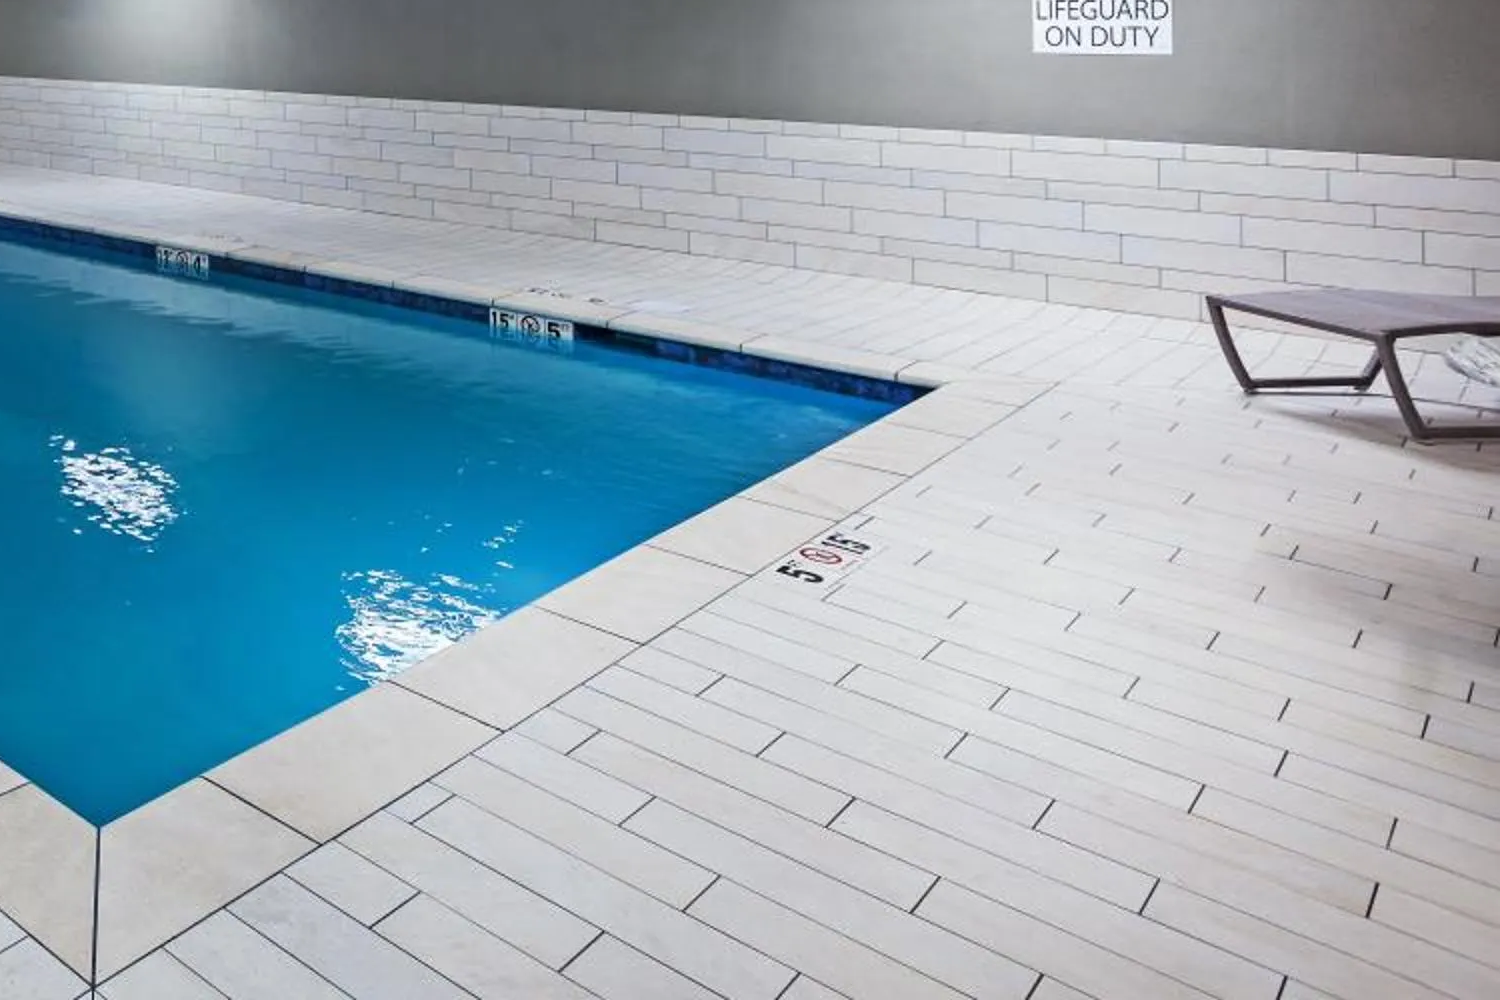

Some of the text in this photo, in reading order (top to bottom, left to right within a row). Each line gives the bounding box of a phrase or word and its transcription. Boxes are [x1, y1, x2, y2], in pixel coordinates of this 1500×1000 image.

[1036, 0, 1169, 20] LIFEGUARD
[1045, 26, 1159, 47] ON DUTY
